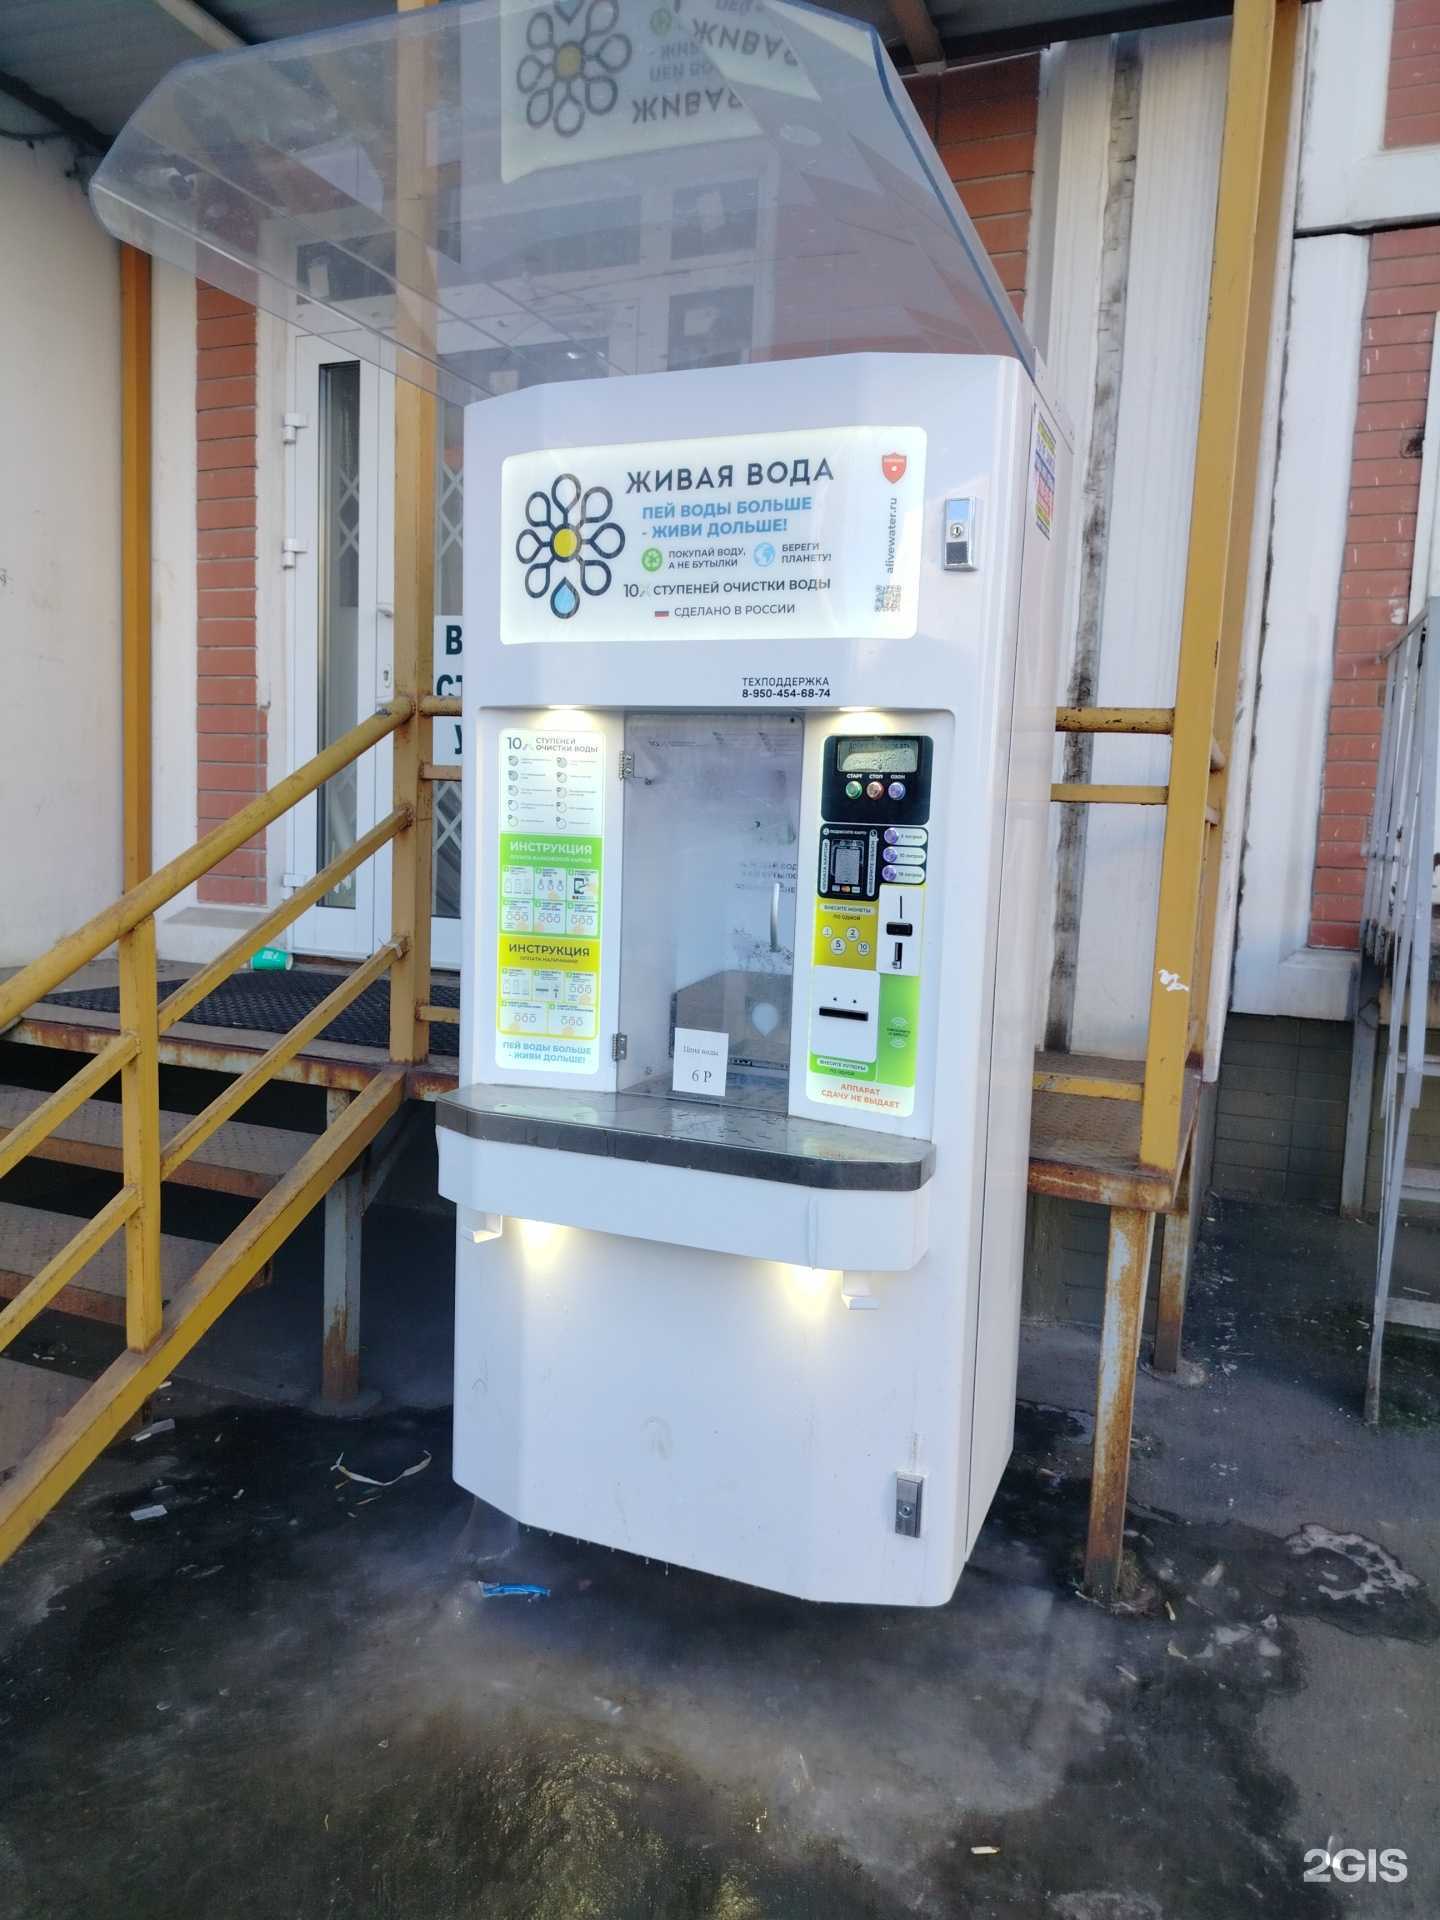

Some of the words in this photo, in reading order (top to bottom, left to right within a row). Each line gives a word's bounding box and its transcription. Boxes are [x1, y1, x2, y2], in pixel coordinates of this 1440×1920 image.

[625, 465, 733, 494] ЖИВАЯ
[746, 457, 835, 487] ВОДА
[642, 502, 675, 521] ПЕЙ
[681, 501, 732, 519] ВОДЫ
[736, 496, 812, 514] БОЛЬШЕ
[651, 524, 702, 539] ЖИВИ
[707, 518, 788, 538] ДОЛЬШЕ!
[885, 497, 898, 574] alivewater.ru
[668, 547, 715, 559] ПОКУПАЙ
[717, 547, 746, 558] ВОДУ,
[781, 543, 820, 552] БЕРЕГИ
[668, 562, 675, 570] А
[677, 561, 690, 569] НЕ
[692, 558, 738, 569] БУТЫЛКИ
[781, 553, 832, 564] ПЛАНЕТУ!
[653, 581, 719, 596] СТУПЕНЕЙ
[723, 580, 785, 593] ОЧИСТКИ
[789, 578, 831, 591] ВОДЫ
[674, 606, 731, 618] СДЕЛАНО
[735, 605, 742, 615] В
[745, 604, 795, 615] РОССИИ
[742, 677, 830, 688] ТЕХПОДДЕРЖКА
[742, 688, 831, 698] 8-950-454-68-74
[535, 737, 576, 745] СТУПЕНЕЙ
[535, 744, 572, 753] ОЧИСТКИ
[509, 841, 593, 856] ИНСТРУКЦИЯ
[509, 943, 590, 957] ИНСТРУКЦИЯ
[835, 939, 841, 948] 5
[503, 1041, 522, 1049] ПЕЙ
[522, 1042, 550, 1052] ВОДЫ
[552, 1044, 591, 1055] БОЛЬШЕ
[514, 1051, 542, 1060] ЖИВИ
[543, 1053, 586, 1064] ДОЛЬШЕ!
[691, 1069, 700, 1082] 6
[703, 1070, 712, 1083] Р
[840, 1083, 881, 1096] АППАРАТ
[821, 1089, 849, 1101] СДАЧУ
[851, 1092, 862, 1102] НЕ
[863, 1095, 900, 1110] ВЫДАЕТ
